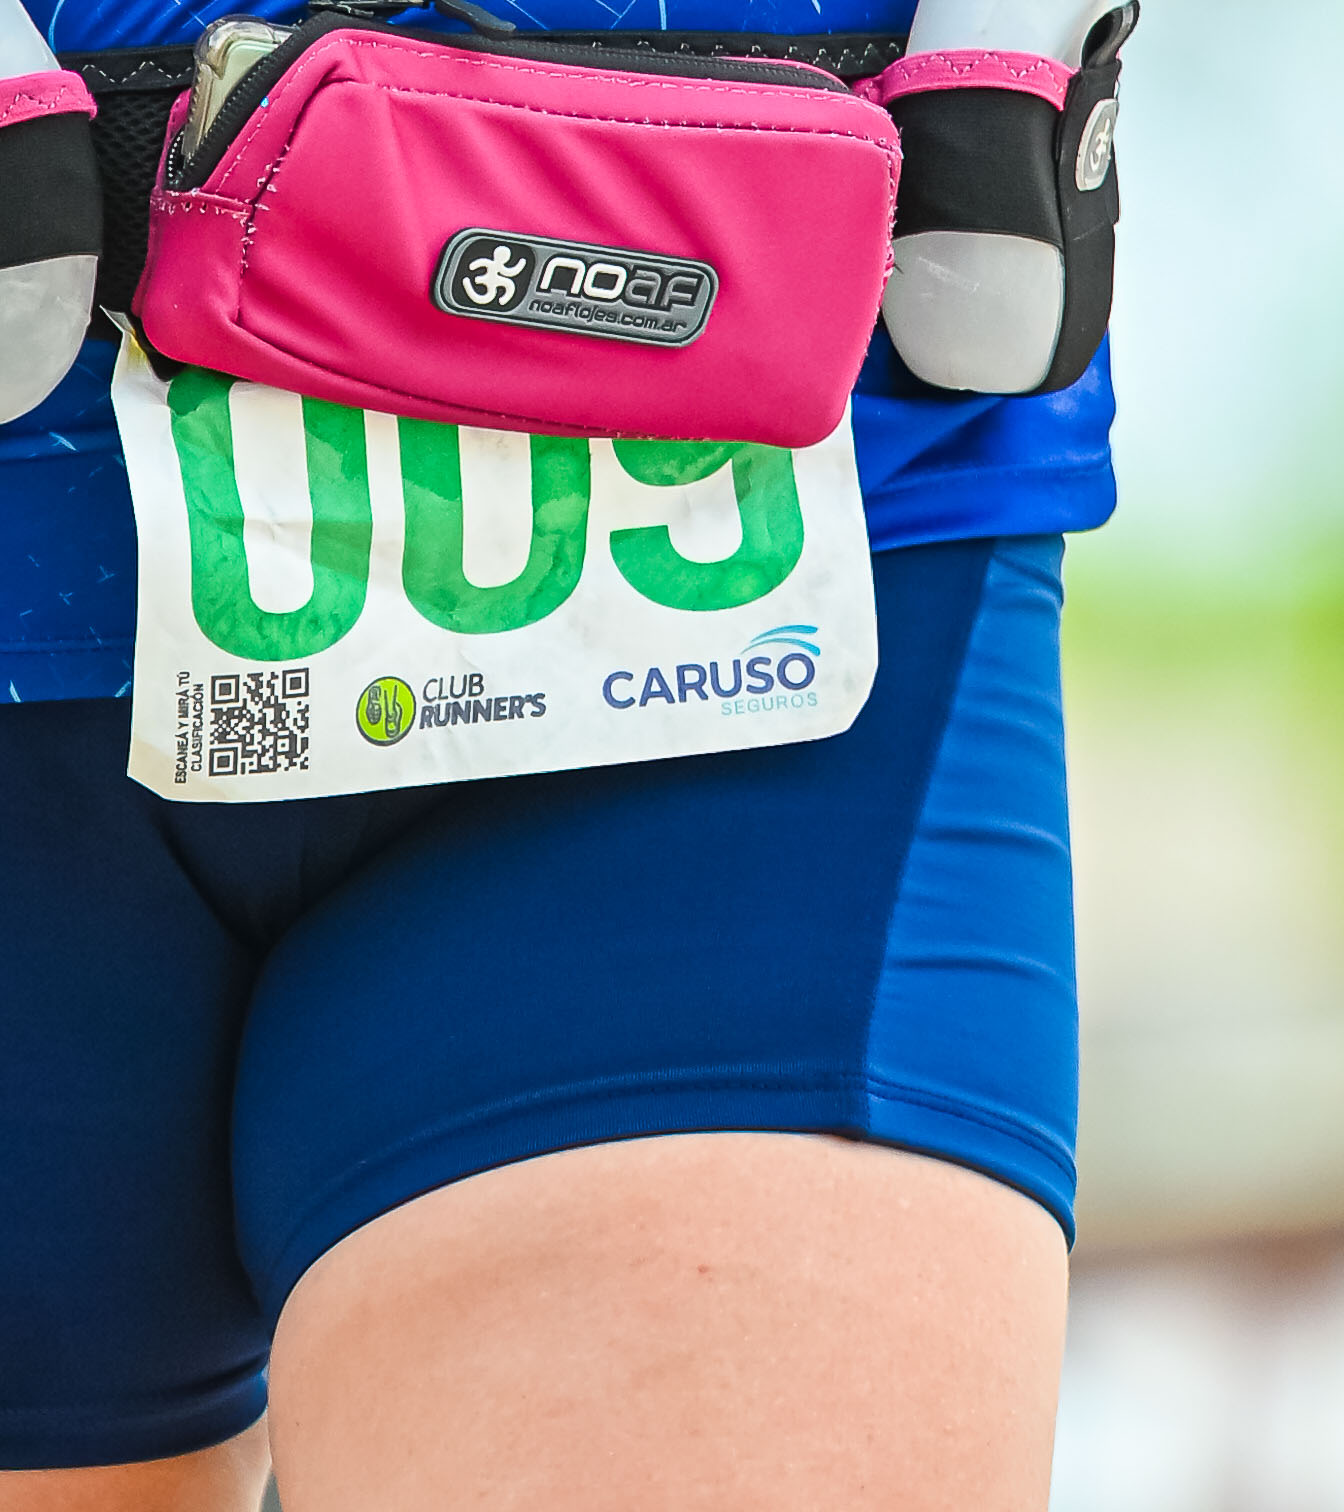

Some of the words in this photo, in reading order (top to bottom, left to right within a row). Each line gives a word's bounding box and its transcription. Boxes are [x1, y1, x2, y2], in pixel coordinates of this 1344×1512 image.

[538, 255, 699, 307] noaf
[528, 299, 688, 333] noaflojes.com.ar
[422, 673, 485, 703] CLUB
[601, 652, 816, 710] CARUSO
[175, 689, 190, 718] MIRÁ
[419, 693, 547, 729] RUNNER'S
[720, 691, 818, 716] SEGUROS
[177, 721, 189, 731] Y
[190, 683, 204, 772] CLASIFICACIÓN
[174, 731, 189, 784] ESCANEÁ
